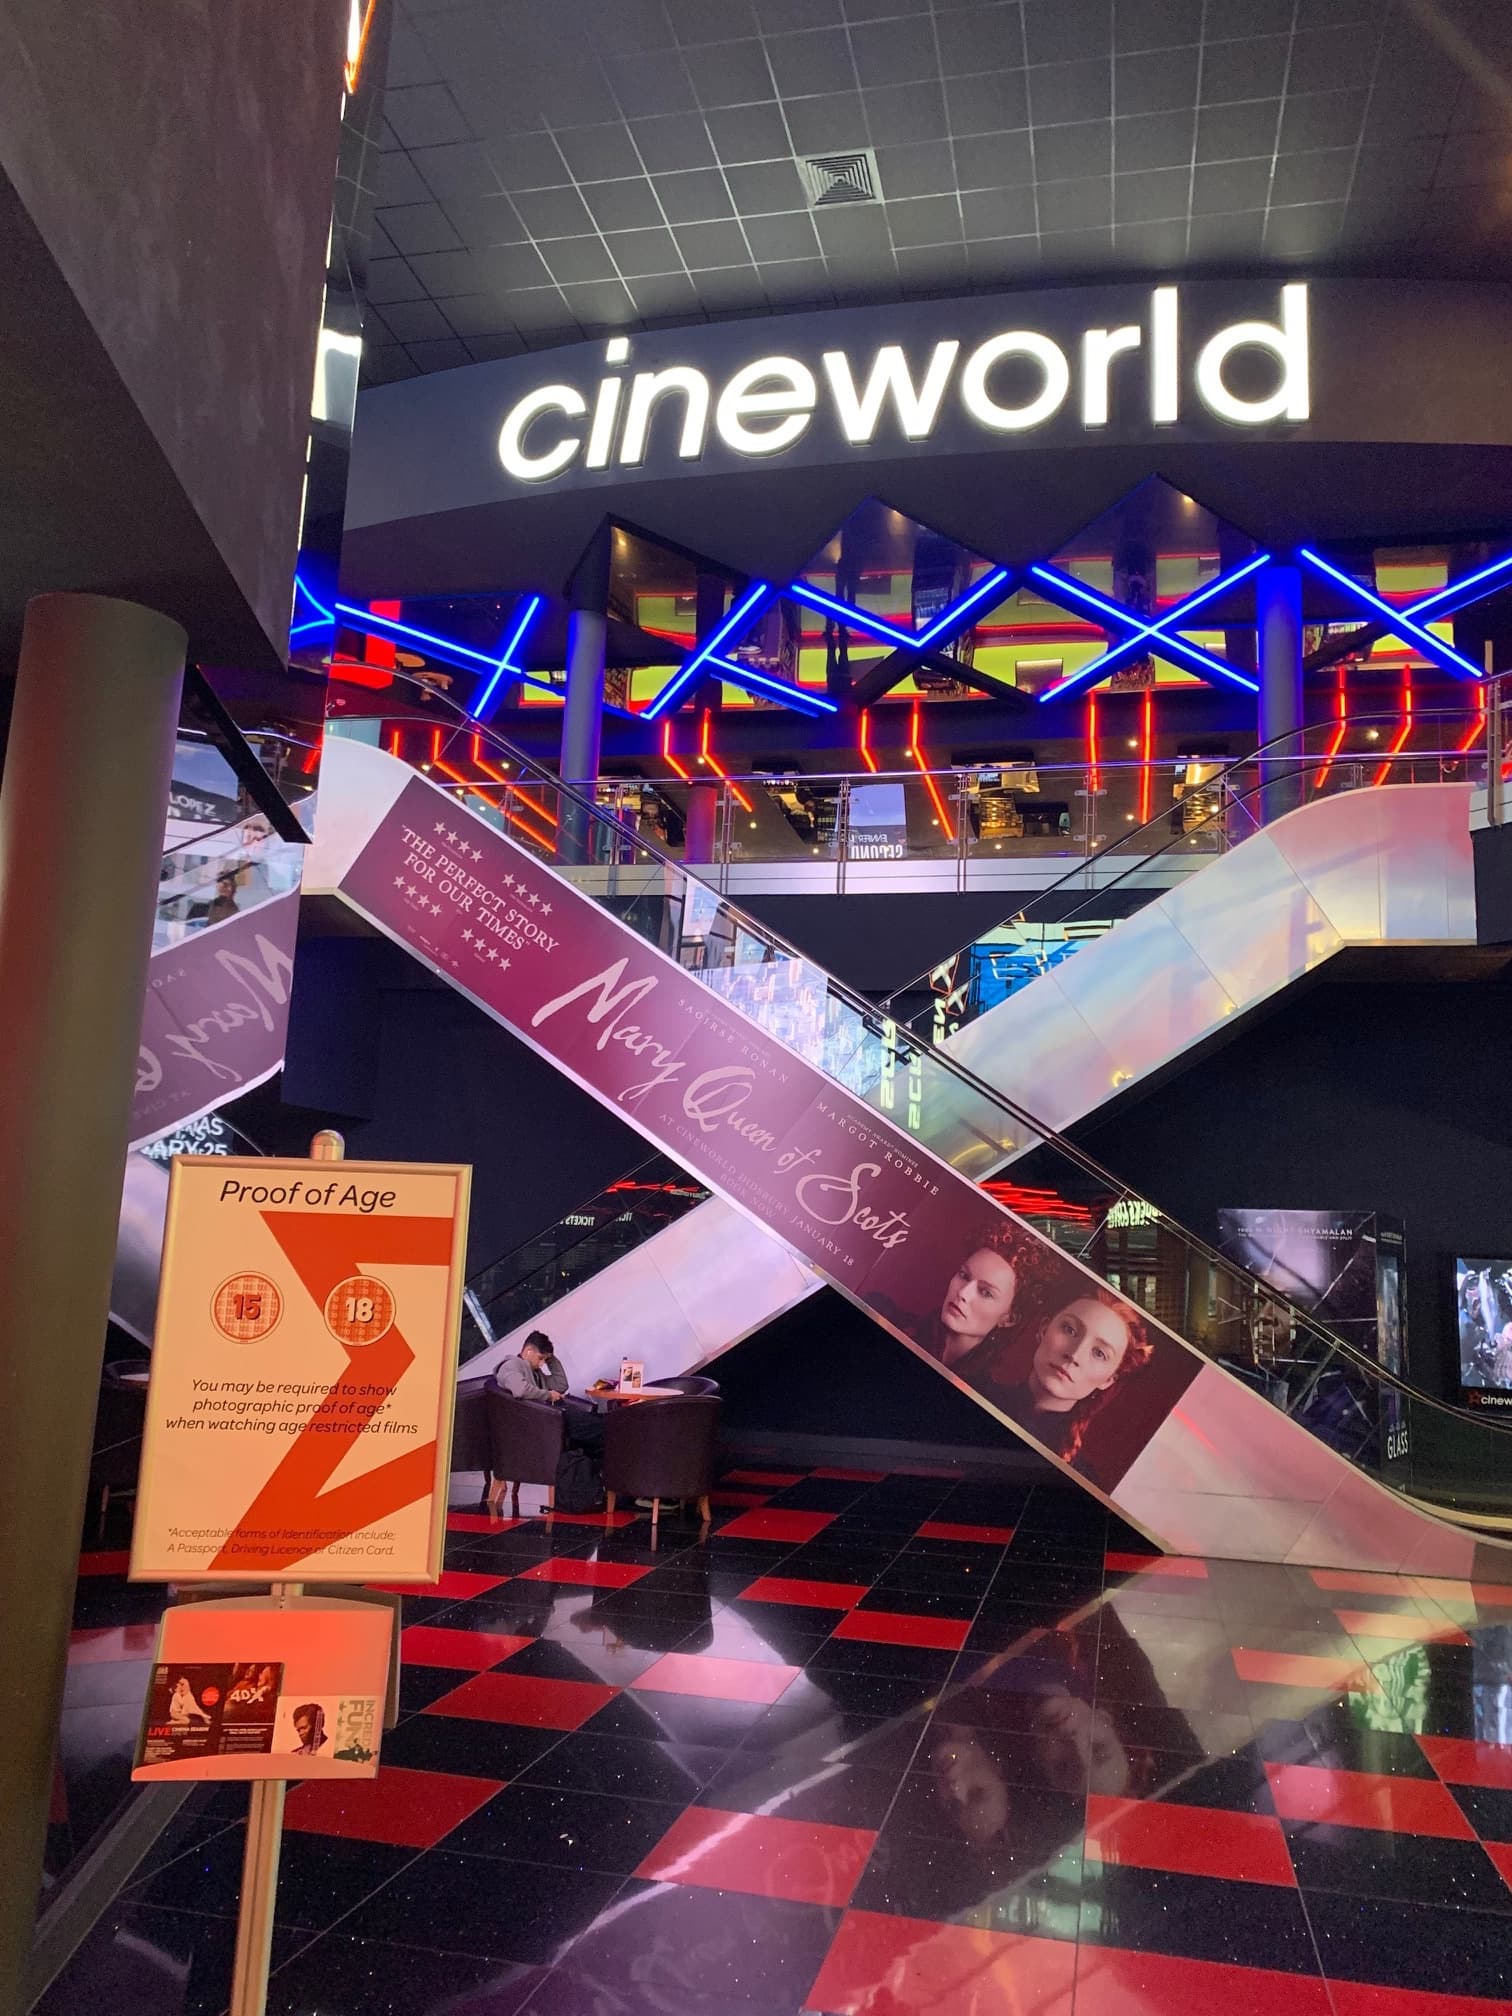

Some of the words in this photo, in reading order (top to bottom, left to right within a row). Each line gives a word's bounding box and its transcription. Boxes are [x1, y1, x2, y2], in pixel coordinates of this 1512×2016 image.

[497, 283, 1311, 482] cineworld
[403, 852, 436, 884] FOR
[438, 879, 473, 913] OUR
[435, 855, 506, 913] PERFECT
[505, 908, 560, 954] STORY
[531, 957, 687, 1101] Mary
[678, 999, 736, 1043] SAOIRSE
[742, 1046, 789, 1084] RONAN
[682, 1065, 777, 1153] Queen
[774, 1146, 822, 1174] of
[816, 1101, 878, 1149] MARGOT
[884, 1151, 940, 1196] ROBBIE
[219, 1180, 303, 1205] Proof
[304, 1183, 338, 1206] of
[338, 1184, 397, 1214] Age
[658, 1113, 675, 1127] AT
[676, 1125, 737, 1174] CINEWORLD
[790, 1215, 842, 1256] JANUARY
[842, 1254, 855, 1267] 18
[795, 1162, 912, 1250] Scots
[233, 1293, 262, 1321] 15
[345, 1297, 375, 1324] 18
[193, 1379, 219, 1392] You
[220, 1381, 254, 1396] may
[256, 1380, 274, 1393] be
[276, 1381, 340, 1398] required
[342, 1384, 356, 1396] to
[359, 1383, 397, 1396] show
[193, 1398, 294, 1415] photographic
[295, 1400, 339, 1416] proof
[339, 1401, 357, 1414] of
[165, 1416, 205, 1430] when
[208, 1418, 276, 1435] watching
[278, 1421, 307, 1435] age
[308, 1420, 382, 1434] restricted
[383, 1420, 418, 1435] films
[1387, 1430, 1409, 1459] GLASS
[234, 1528, 268, 1539] forms
[268, 1528, 281, 1538] of
[282, 1529, 353, 1540] Identification
[167, 1544, 175, 1553] A
[231, 1544, 270, 1556] Driving
[270, 1545, 313, 1555] Licence
[313, 1546, 326, 1555] or
[327, 1544, 364, 1555] Citizen
[230, 1685, 271, 1704] 4DX
[147, 1727, 171, 1736] LIVE
